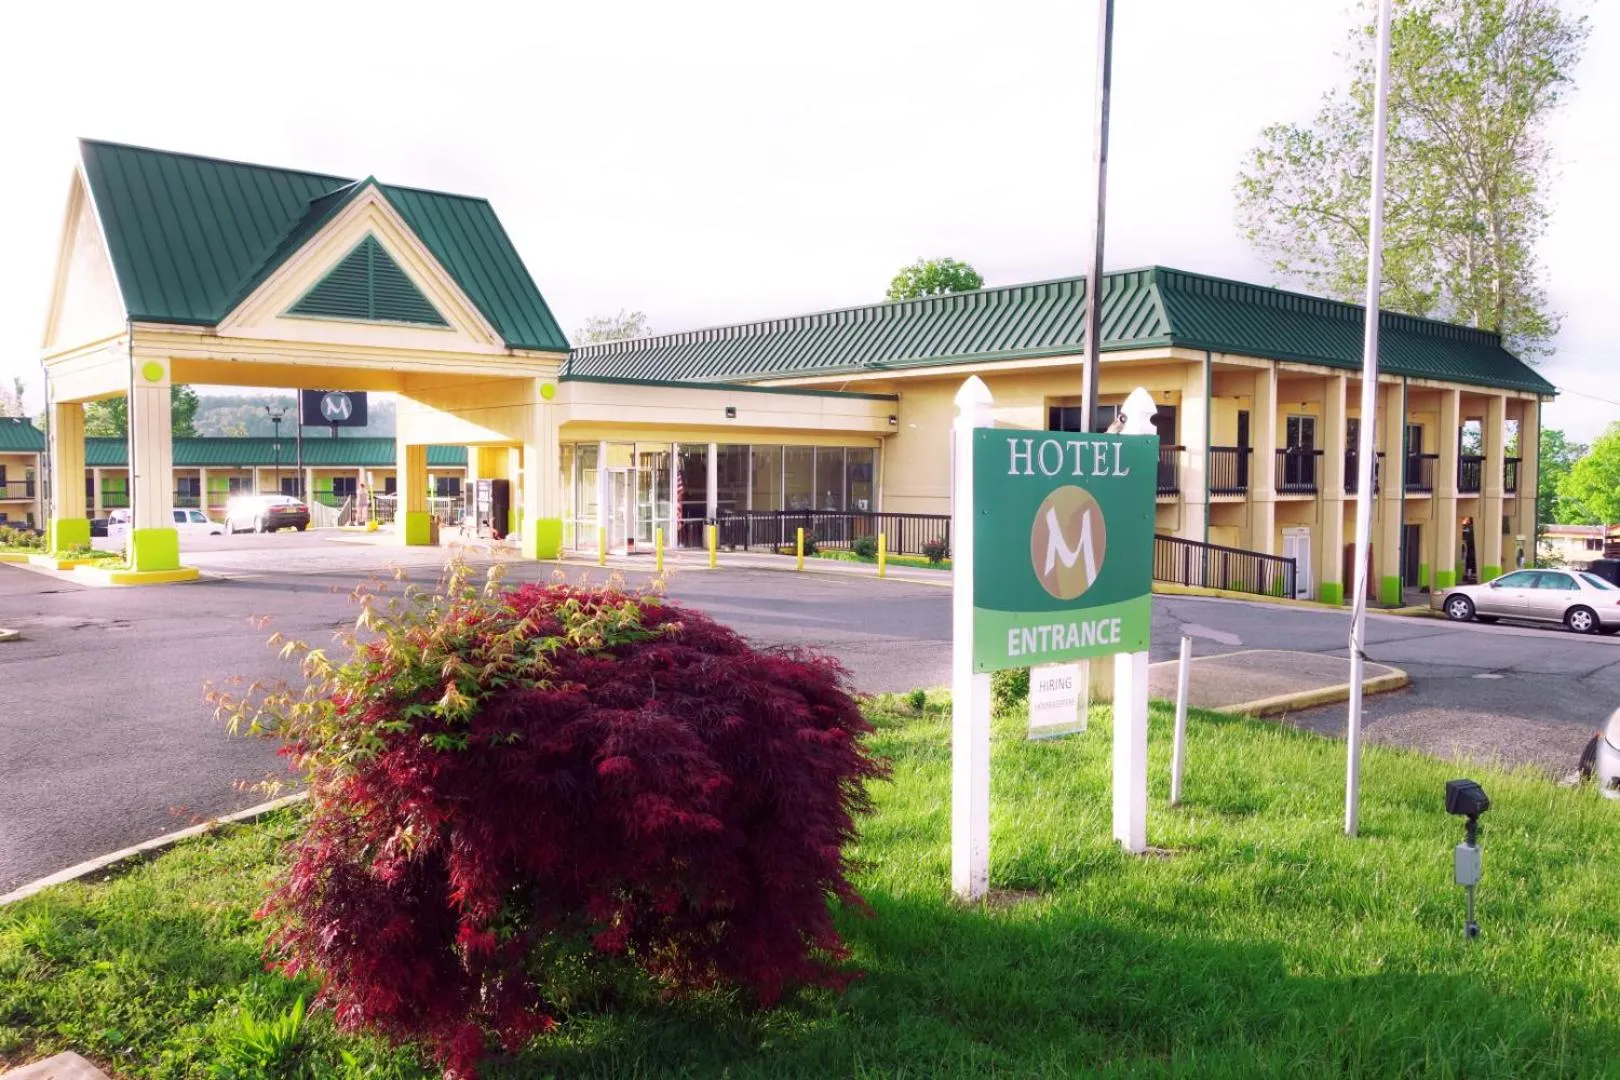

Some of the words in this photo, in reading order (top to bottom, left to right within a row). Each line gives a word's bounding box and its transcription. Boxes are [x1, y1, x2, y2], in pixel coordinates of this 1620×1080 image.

[326, 397, 349, 420] M
[1006, 438, 1130, 476] HOTEL
[1044, 506, 1096, 588] M
[1008, 618, 1122, 656] ENTRANCE
[1039, 676, 1072, 692] HIRING
